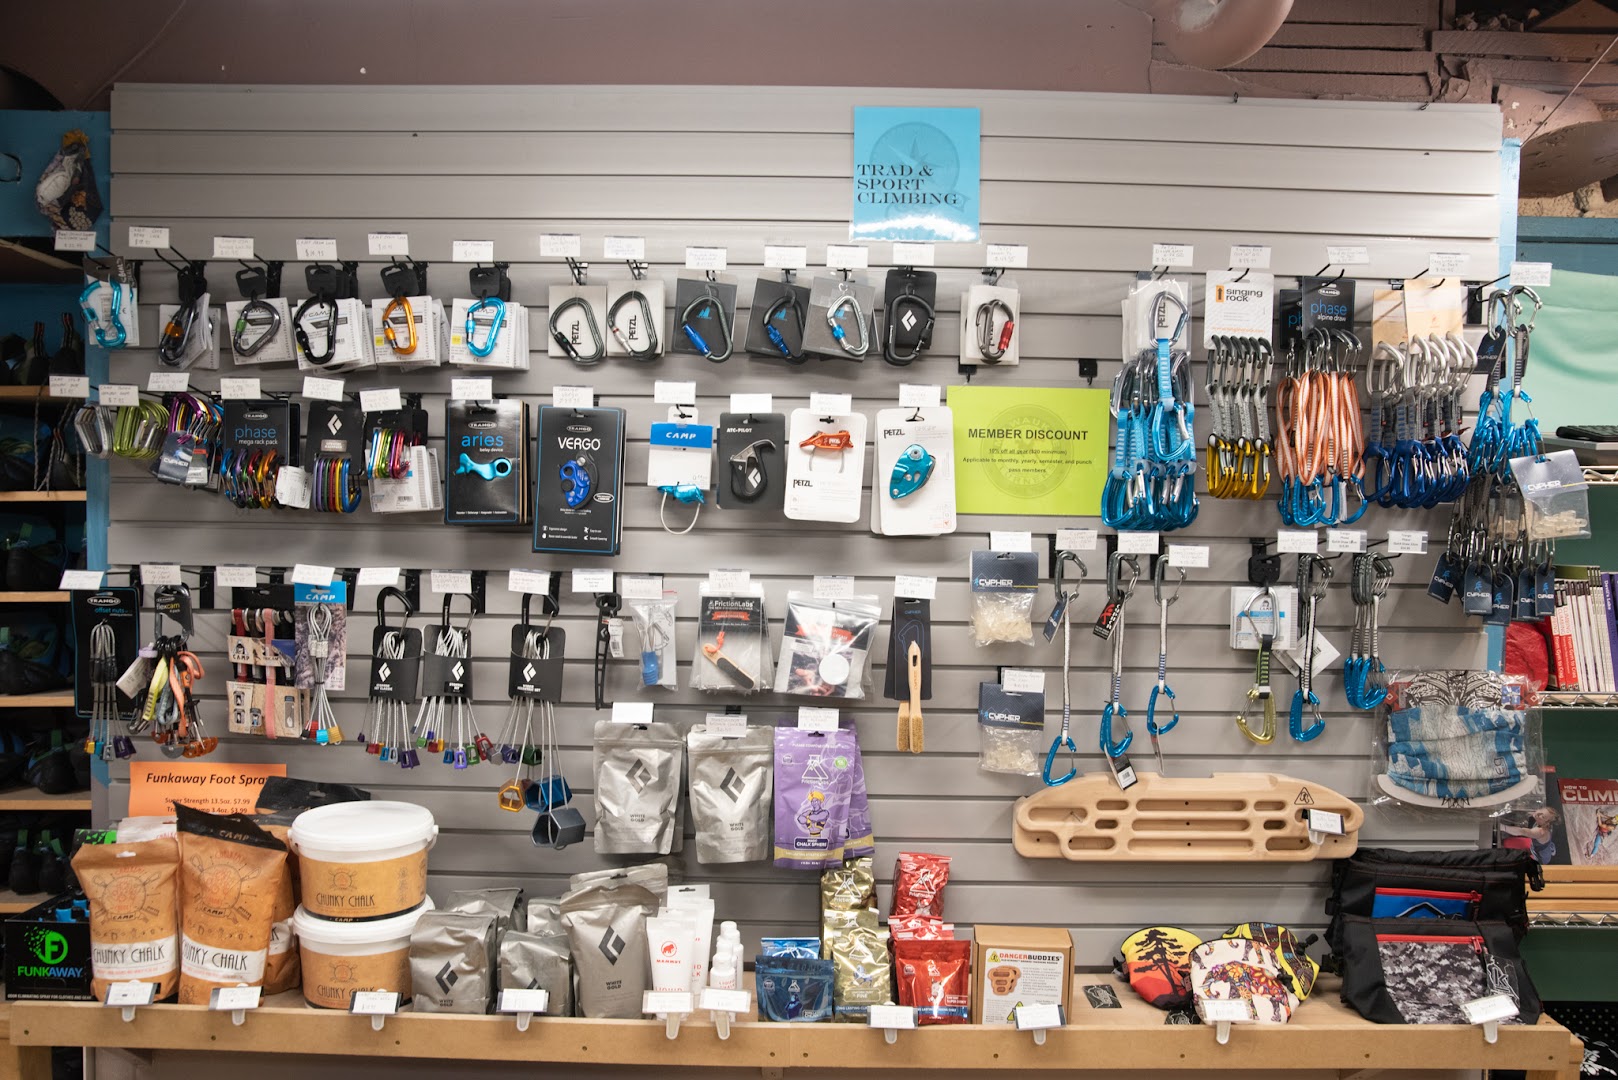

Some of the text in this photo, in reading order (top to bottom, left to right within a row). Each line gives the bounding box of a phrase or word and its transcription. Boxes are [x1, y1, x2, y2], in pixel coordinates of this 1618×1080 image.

[857, 164, 934, 177] TRAD &
[857, 178, 925, 191] SPORT
[857, 192, 958, 205] CLIMBING
[1226, 288, 1263, 298] singing
[1226, 295, 1249, 303] rock
[1310, 299, 1348, 316] phase
[1157, 301, 1169, 328] PETZL
[1317, 313, 1347, 322] alpine draw
[571, 320, 582, 346] PETZL
[628, 314, 638, 341] PETZL
[234, 424, 277, 441] phase
[665, 431, 697, 440] CAMP
[883, 428, 905, 439] PETZL
[968, 428, 1089, 441] MEMBER DISCOUNT
[238, 438, 254, 446] mega
[461, 431, 504, 448] aries
[557, 436, 602, 451] VERGO
[793, 479, 813, 488] PETZL
[1527, 480, 1562, 491] CYPHER
[978, 578, 1014, 587] CYPHER
[1434, 575, 1454, 588] CYPHER
[305, 593, 336, 601] CAMP
[156, 602, 181, 611] flexcam
[988, 712, 1021, 722] CYPHER
[146, 773, 269, 787] Funkaway Foot Spra
[183, 797, 210, 805] Strength
[219, 830, 250, 841] CAMP
[316, 892, 376, 907] CHUNKY CHALK
[202, 907, 224, 916] CAMP
[93, 944, 165, 965] CHUNKY CHALK
[999, 952, 1060, 962] DANGERBUDDIES
[211, 952, 249, 971] CHALK
[17, 966, 83, 977] FUNKAWAY
[317, 984, 346, 999] CHUNKY
